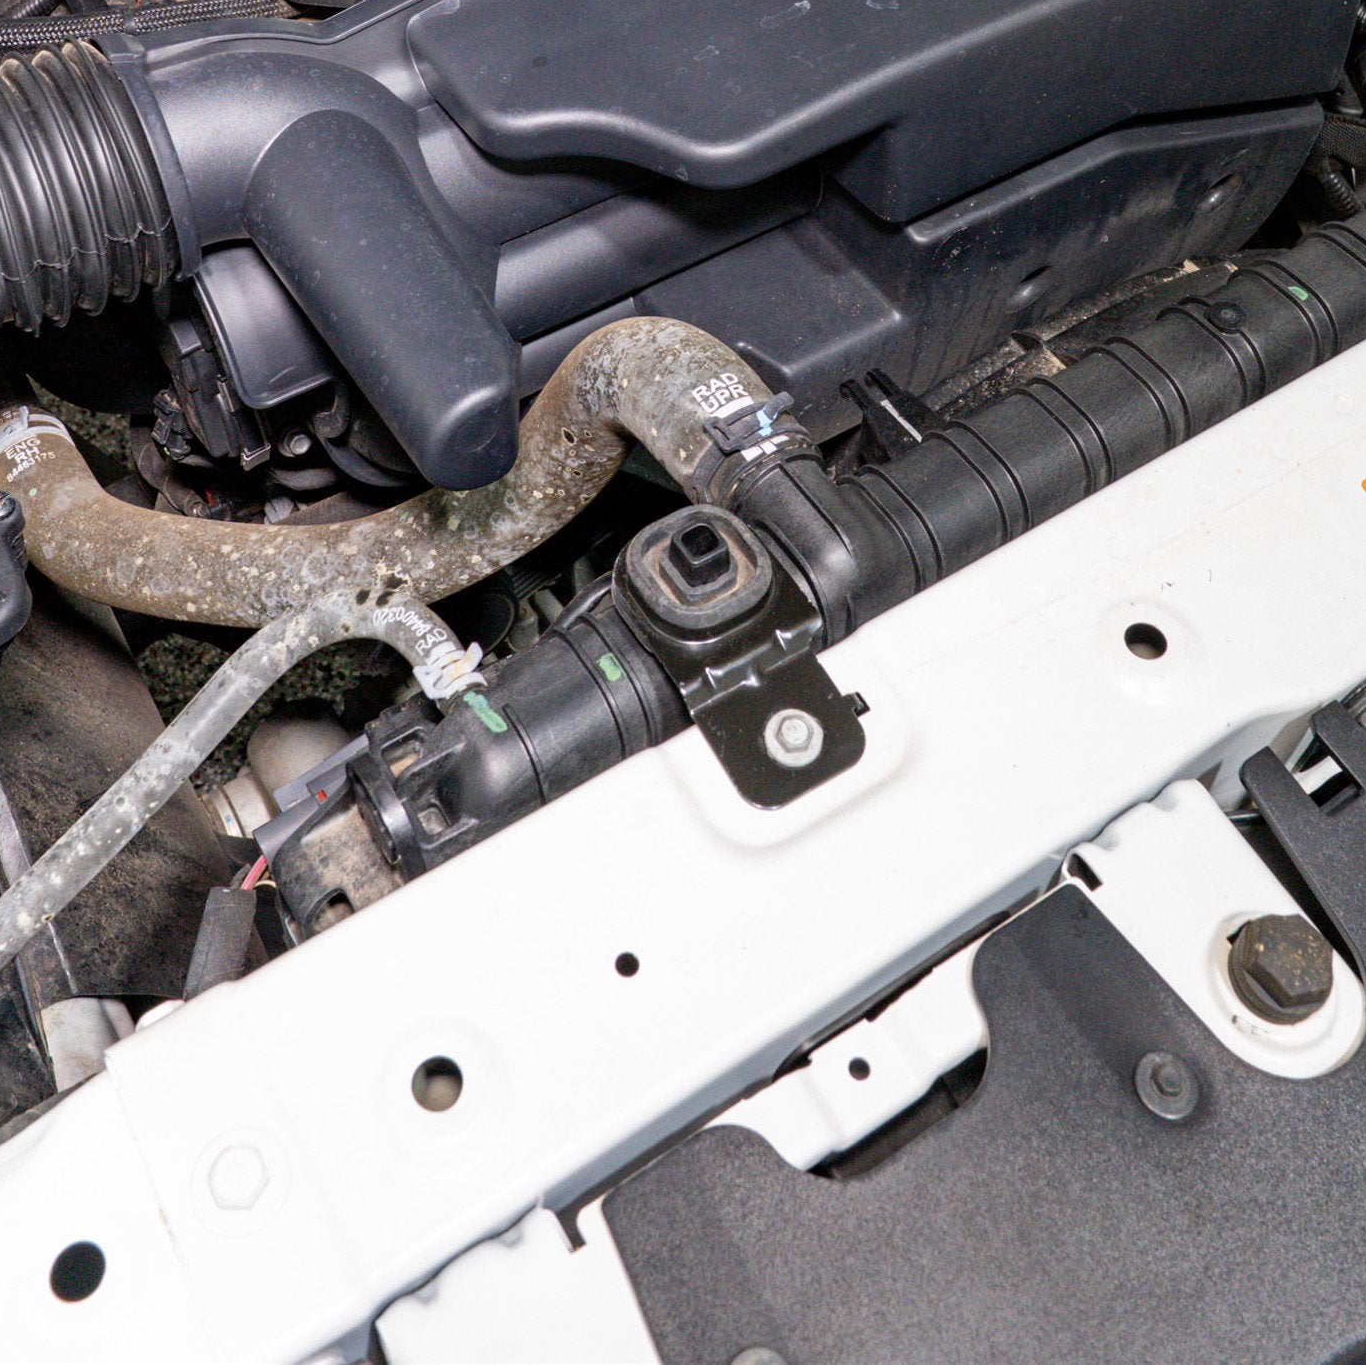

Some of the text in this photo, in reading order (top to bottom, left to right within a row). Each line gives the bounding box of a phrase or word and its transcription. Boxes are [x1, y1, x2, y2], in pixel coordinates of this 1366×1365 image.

[690, 372, 740, 402] RAD
[699, 383, 750, 413] UPR
[5, 438, 42, 460] ENG
[14, 446, 40, 464] RH
[372, 606, 431, 638] 84400320
[415, 627, 448, 656] RAD
